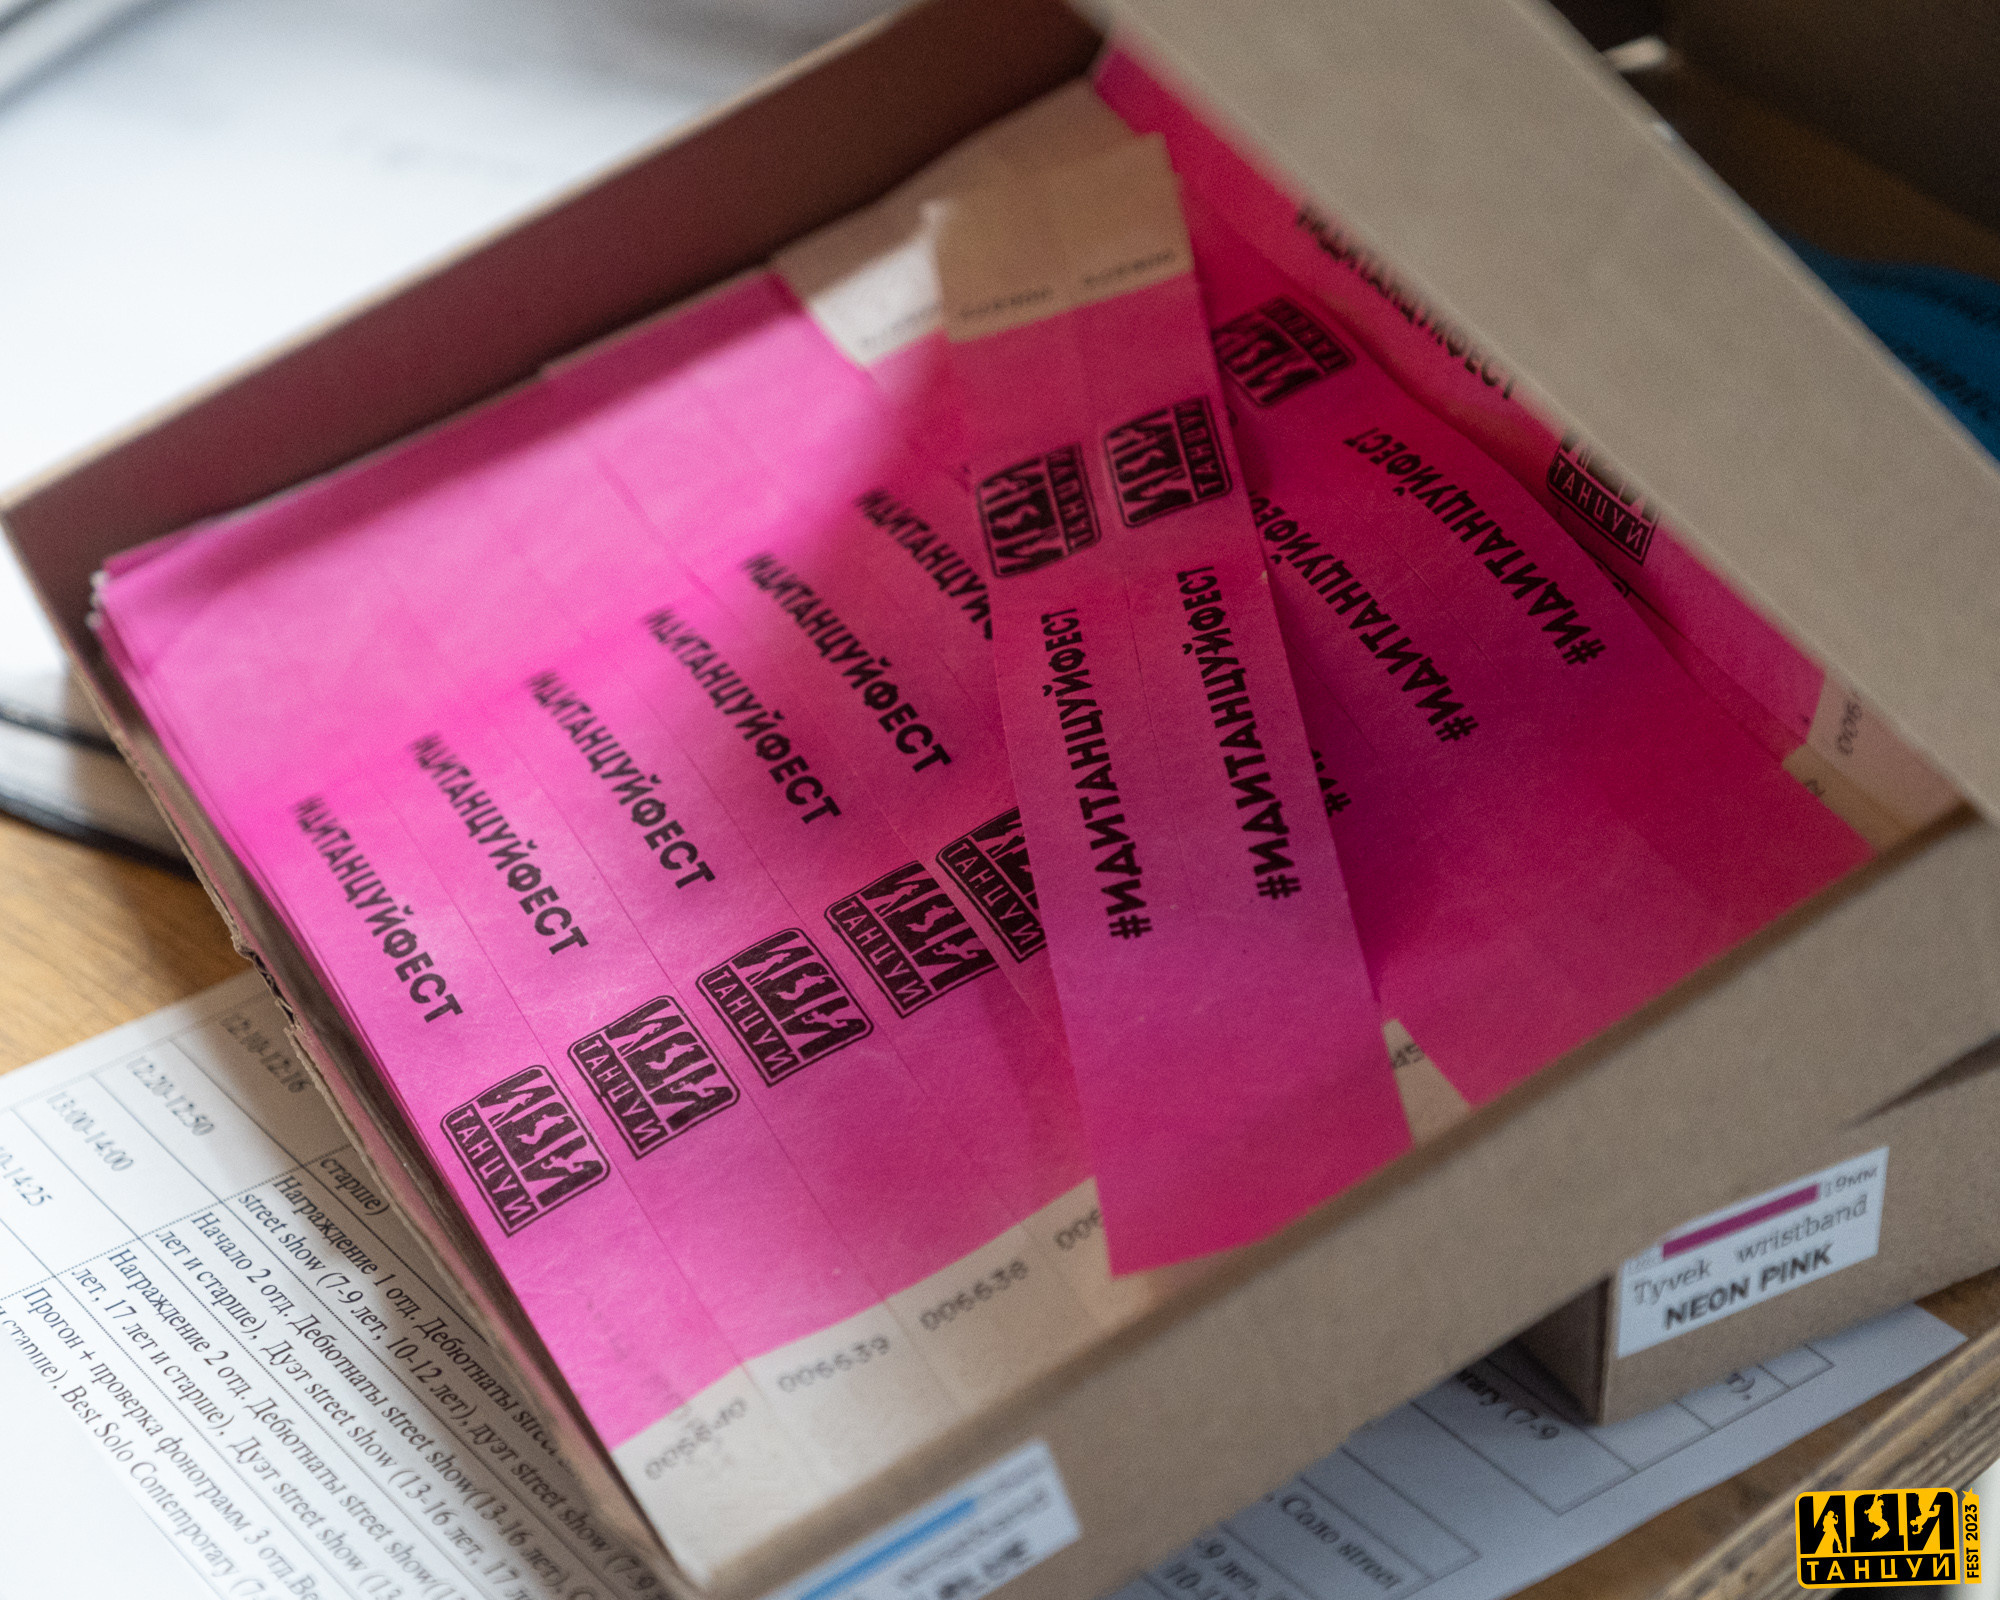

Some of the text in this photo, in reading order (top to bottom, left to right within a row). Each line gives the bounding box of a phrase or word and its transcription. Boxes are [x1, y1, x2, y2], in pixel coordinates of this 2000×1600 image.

[1342, 426, 1606, 667] #ИДИТАНЦУЙФЕСТ
[1040, 607, 1154, 940] #ИДИТАНЦУЙФЕСТ
[1176, 566, 1301, 900] #ИДИТАНЦУЙФЕСТ
[272, 1175, 378, 1275] Награждение
[373, 1273, 397, 1287] 1
[386, 1287, 422, 1321] отд.
[413, 1316, 519, 1412] Дебютнаты
[319, 1156, 390, 1216] старше)
[1633, 1193, 1869, 1307] Tyvek wristband
[1663, 1242, 1835, 1331] NEON PINK
[22, 1286, 85, 1349] Прогон
[89, 1362, 164, 1437] проверка
[154, 1434, 253, 1534] фонограмм
[244, 1528, 270, 1545] 3
[71, 1269, 107, 1302] лет,
[104, 1299, 137, 1320] 17
[122, 1323, 158, 1351] лет
[149, 1351, 171, 1365] и
[162, 1365, 235, 1437] старше),
[228, 1435, 282, 1481] Дуэт
[272, 1479, 327, 1528] street
[316, 1526, 368, 1573] show
[108, 1248, 211, 1353] Награждение
[204, 1350, 229, 1366] 2
[217, 1366, 252, 1400] отд.
[244, 1396, 348, 1497] Дебютнаты
[339, 1495, 394, 1542] street
[155, 1230, 190, 1259] лет
[183, 1257, 203, 1271] и
[196, 1271, 268, 1341] старше),
[259, 1339, 313, 1383] Дуэт
[304, 1382, 356, 1427] street
[347, 1424, 399, 1469] show
[387, 1467, 460, 1527] (13-16
[191, 1211, 253, 1271] Начало
[246, 1268, 271, 1284] 2
[259, 1283, 296, 1318] отд.
[287, 1313, 388, 1407] Дебютнаты
[381, 1406, 435, 1452] street
[238, 1193, 288, 1234] street
[279, 1230, 327, 1273] show
[315, 1271, 365, 1305] (7-9
[350, 1306, 388, 1341] лет,
[385, 1336, 443, 1384] 10-12
[430, 1384, 476, 1427] лет),
[467, 1423, 517, 1463] дуэт
[512, 1461, 565, 1510] street
[558, 1504, 607, 1553] show
[60, 1385, 103, 1426] Best
[94, 1421, 135, 1463] Solo
[129, 1461, 239, 1580] Contemporary
